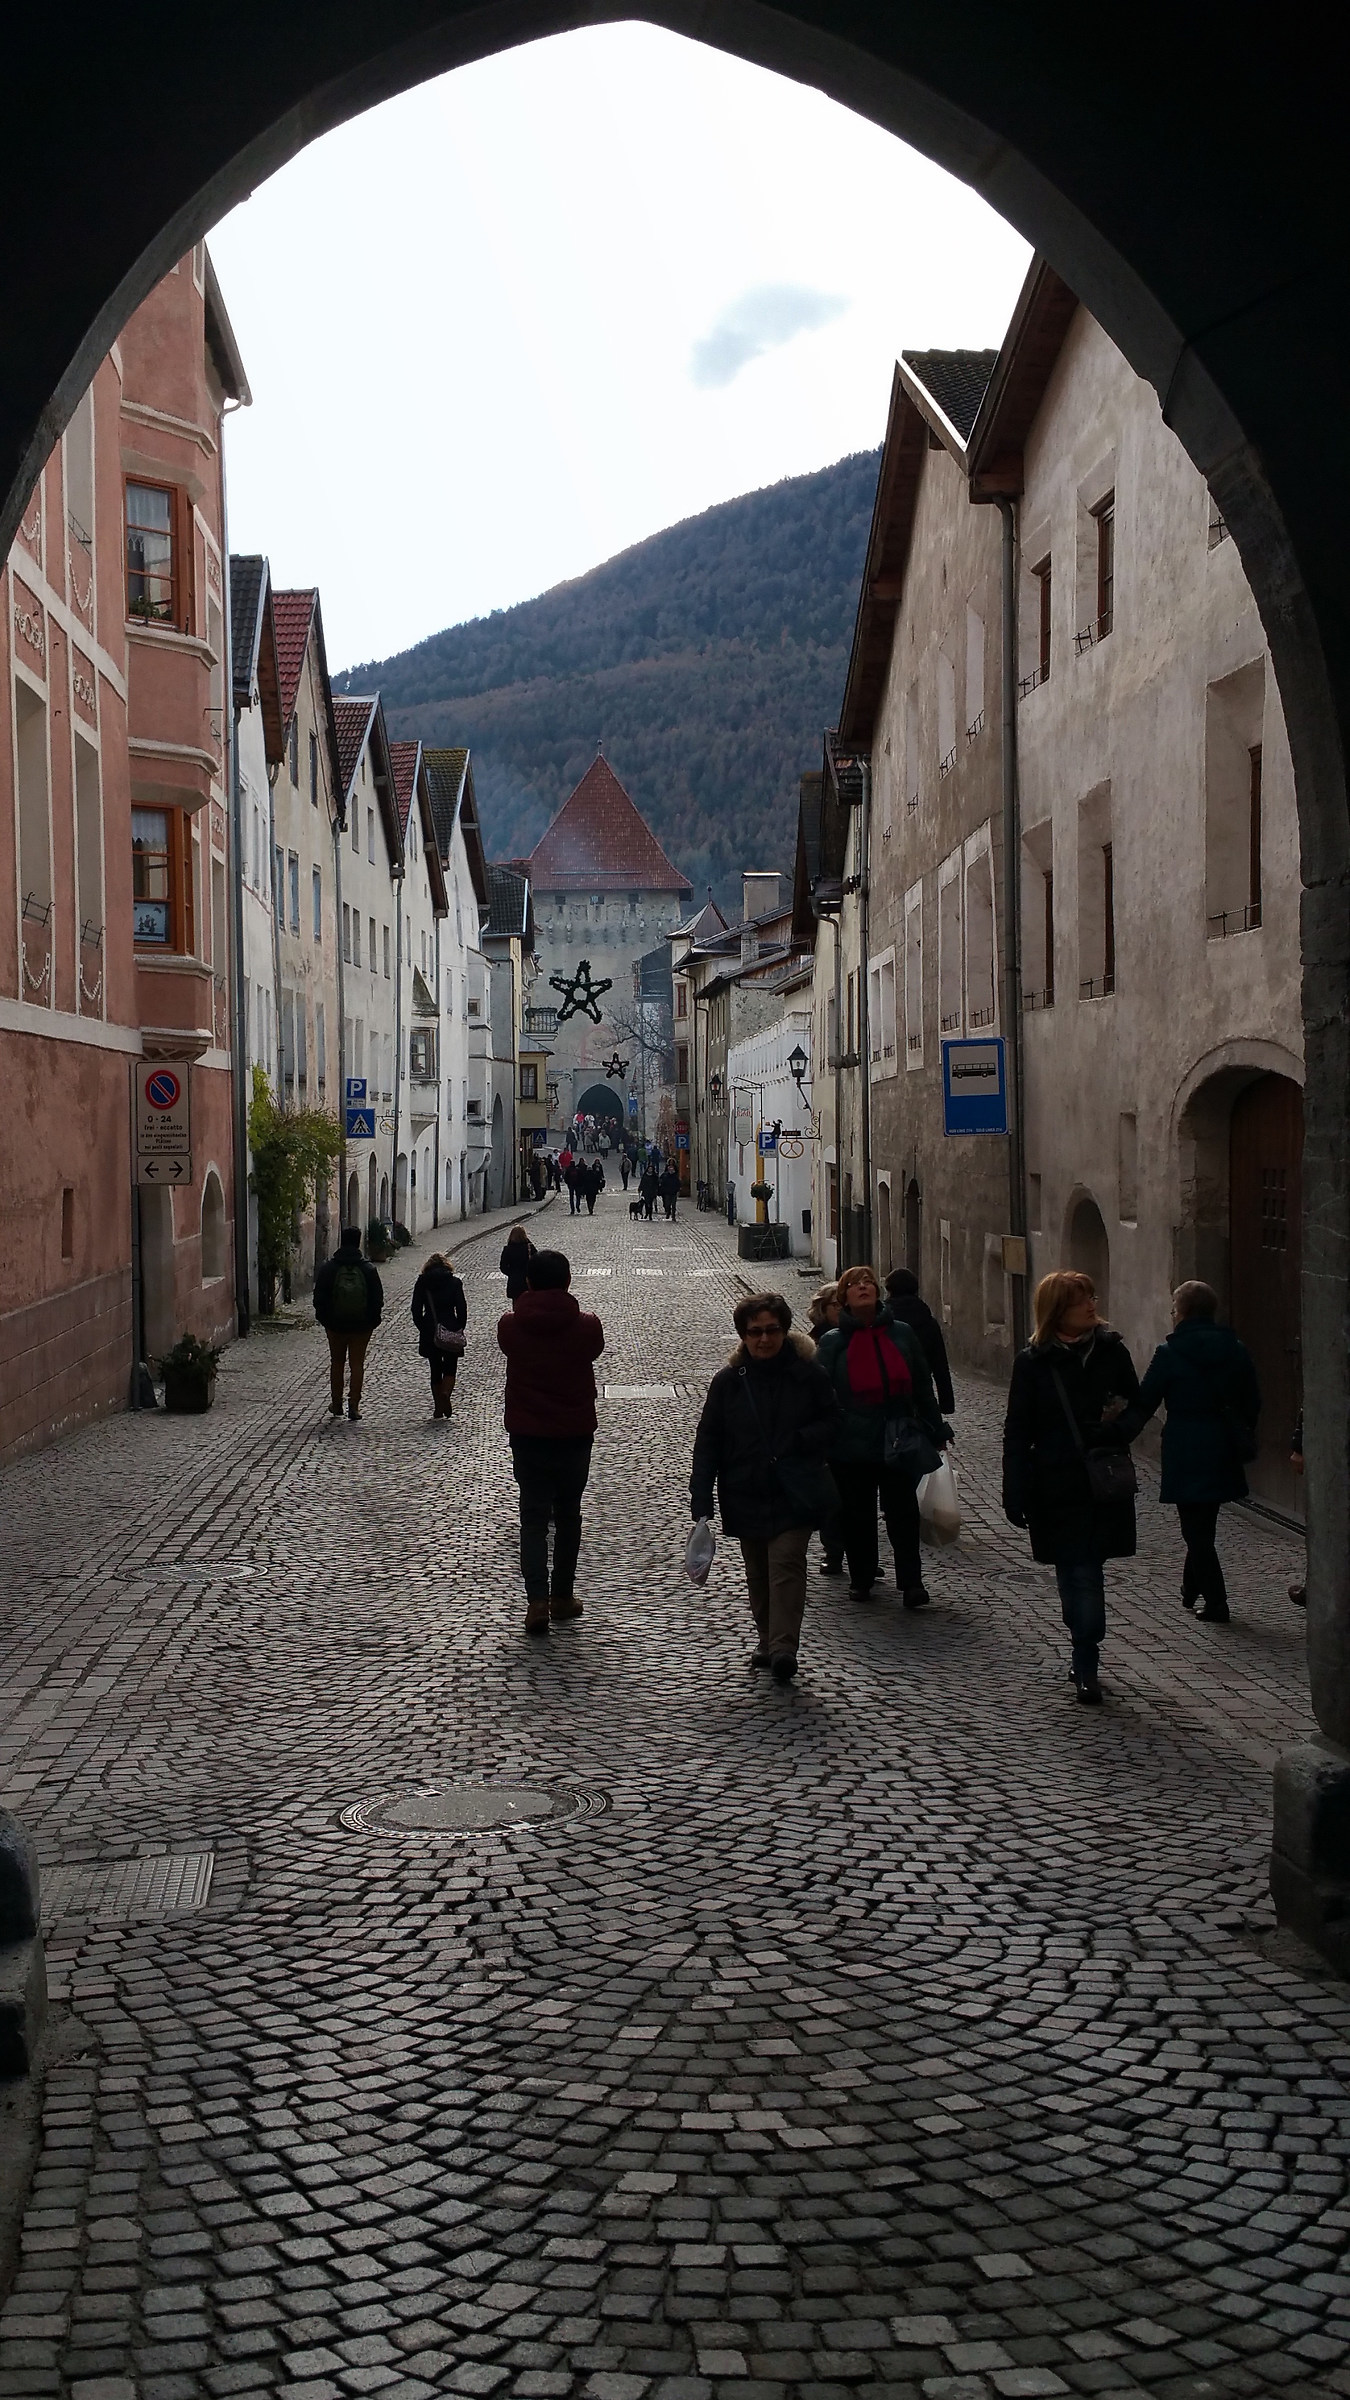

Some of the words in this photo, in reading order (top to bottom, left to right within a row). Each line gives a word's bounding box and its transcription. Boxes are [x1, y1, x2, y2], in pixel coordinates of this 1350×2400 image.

[350, 1080, 363, 1097] P
[147, 1115, 154, 1123] 0
[160, 1115, 172, 1123] 24
[678, 1136, 687, 1148] P
[762, 1134, 772, 1148] P
